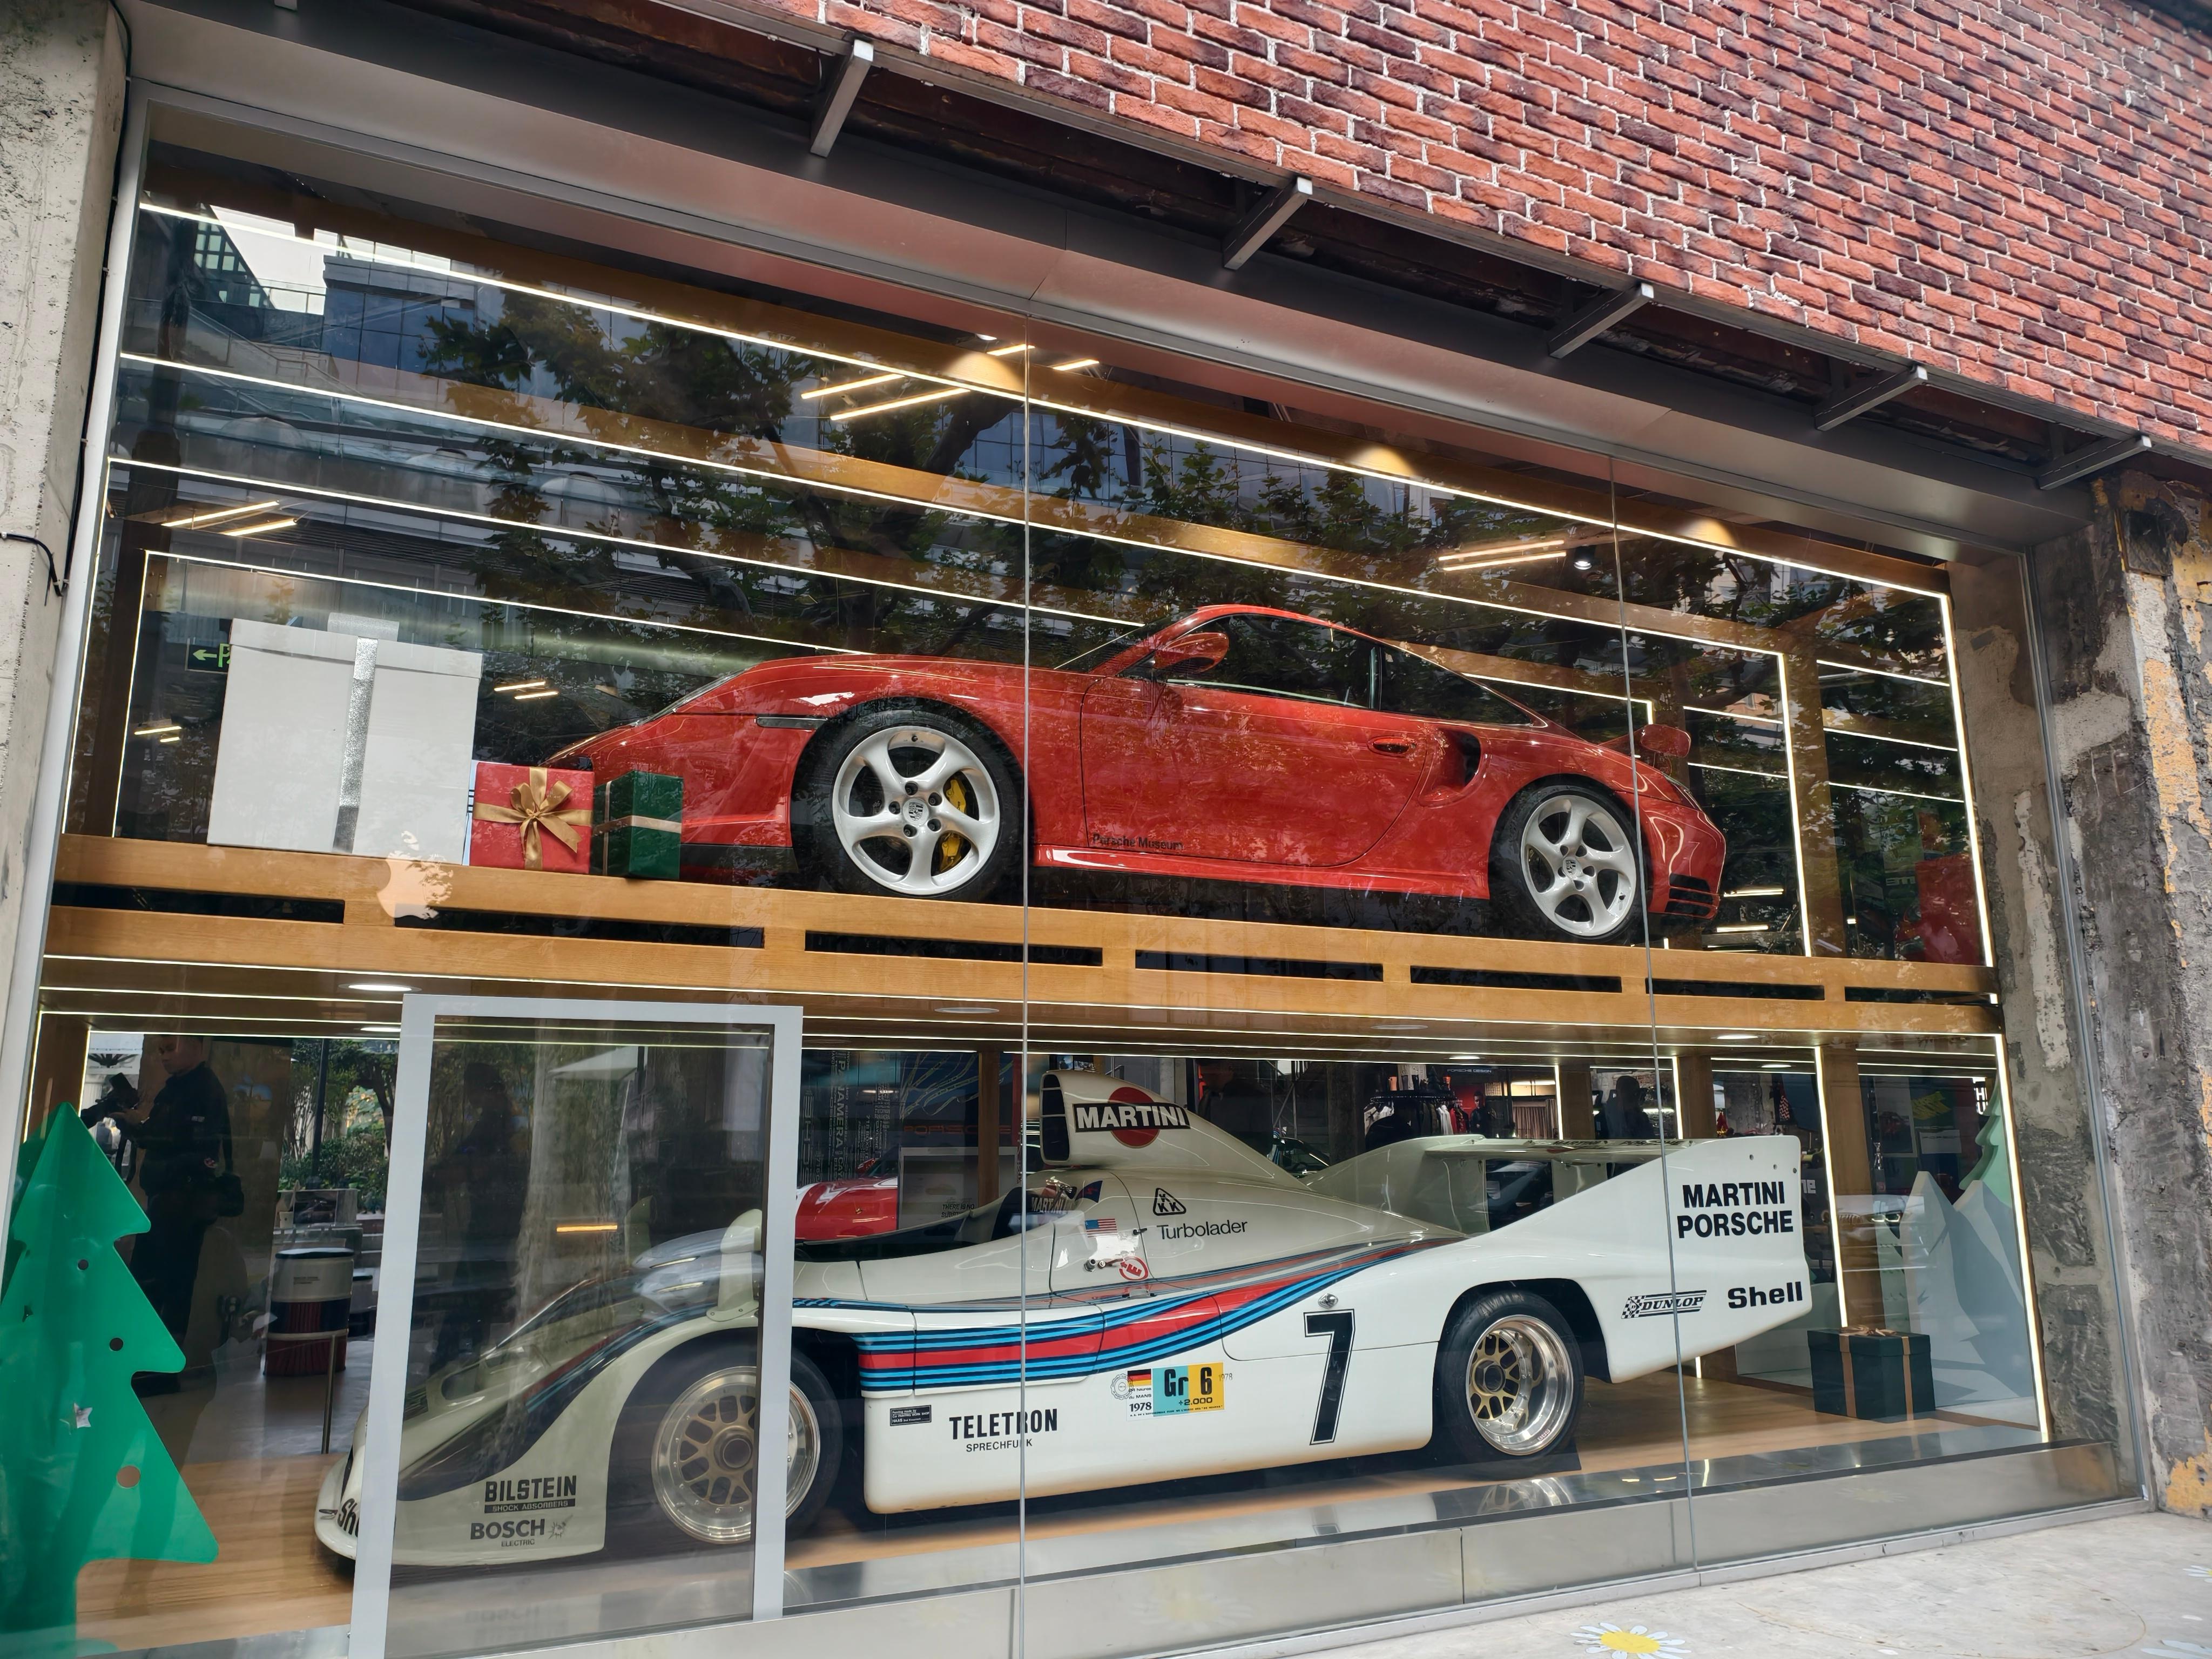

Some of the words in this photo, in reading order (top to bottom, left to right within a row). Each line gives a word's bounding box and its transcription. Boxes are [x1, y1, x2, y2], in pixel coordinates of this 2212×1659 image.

[1093, 833, 1136, 847] Porsche
[1138, 837, 1183, 850] Museum
[1076, 1105, 1186, 1129] MARTINI
[904, 1125, 1012, 1135] PORSCE
[1683, 1182, 1785, 1209] MARTINI
[1156, 1219, 1248, 1240] Turbolader
[1677, 1210, 1793, 1239] PORSCHE
[1642, 1297, 1704, 1311] DUNLOP
[1728, 1281, 1803, 1309] Shell
[1164, 1368, 1189, 1397] Gr
[1200, 1367, 1212, 1395] 6
[1303, 1309, 1355, 1446] 7
[1129, 1402, 1152, 1412] 1978
[949, 1408, 1057, 1440] TELETRON
[966, 1438, 1033, 1452] SPRECHFUK
[484, 1475, 577, 1502] BILSTEIN
[493, 1504, 519, 1512] SHOCK
[522, 1500, 568, 1510] ABSORBERS
[470, 1519, 545, 1540] BOSCH
[501, 1539, 535, 1547] ELECTRIC
